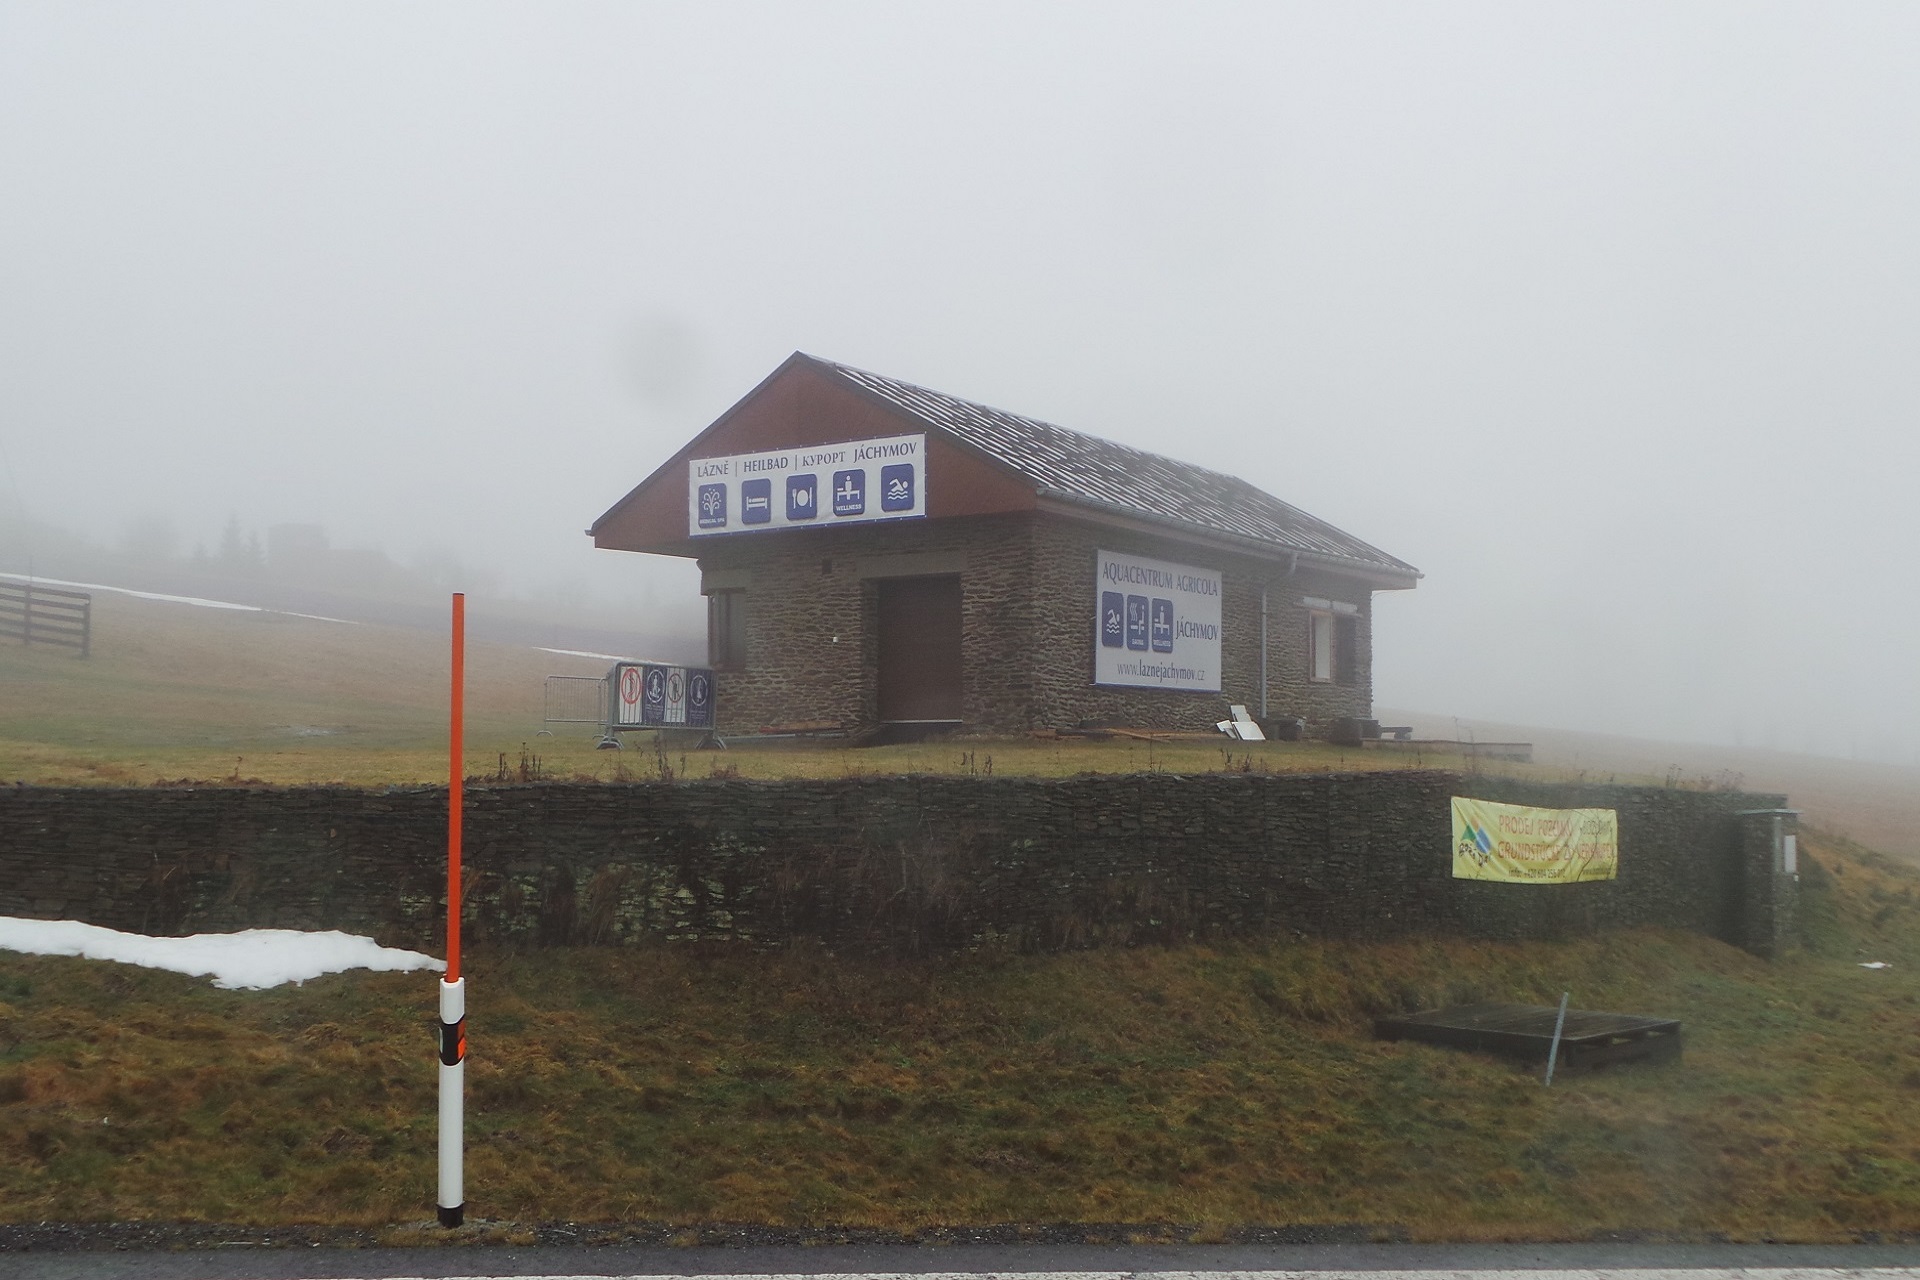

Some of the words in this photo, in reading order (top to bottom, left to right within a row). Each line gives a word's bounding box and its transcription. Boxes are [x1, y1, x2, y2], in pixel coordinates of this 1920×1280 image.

[853, 442, 918, 464] JÁCHYMOV
[697, 461, 729, 478] LÁZNĚ
[743, 457, 789, 472] HEILBAD
[1102, 561, 1173, 590] AQUACENTRUM
[1176, 574, 1218, 597] AGRICOLA
[1175, 616, 1219, 641] JÁCHYMOV
[1117, 659, 1206, 684] www.laznejachymov.cz
[1498, 814, 1533, 835] PRODEJ
